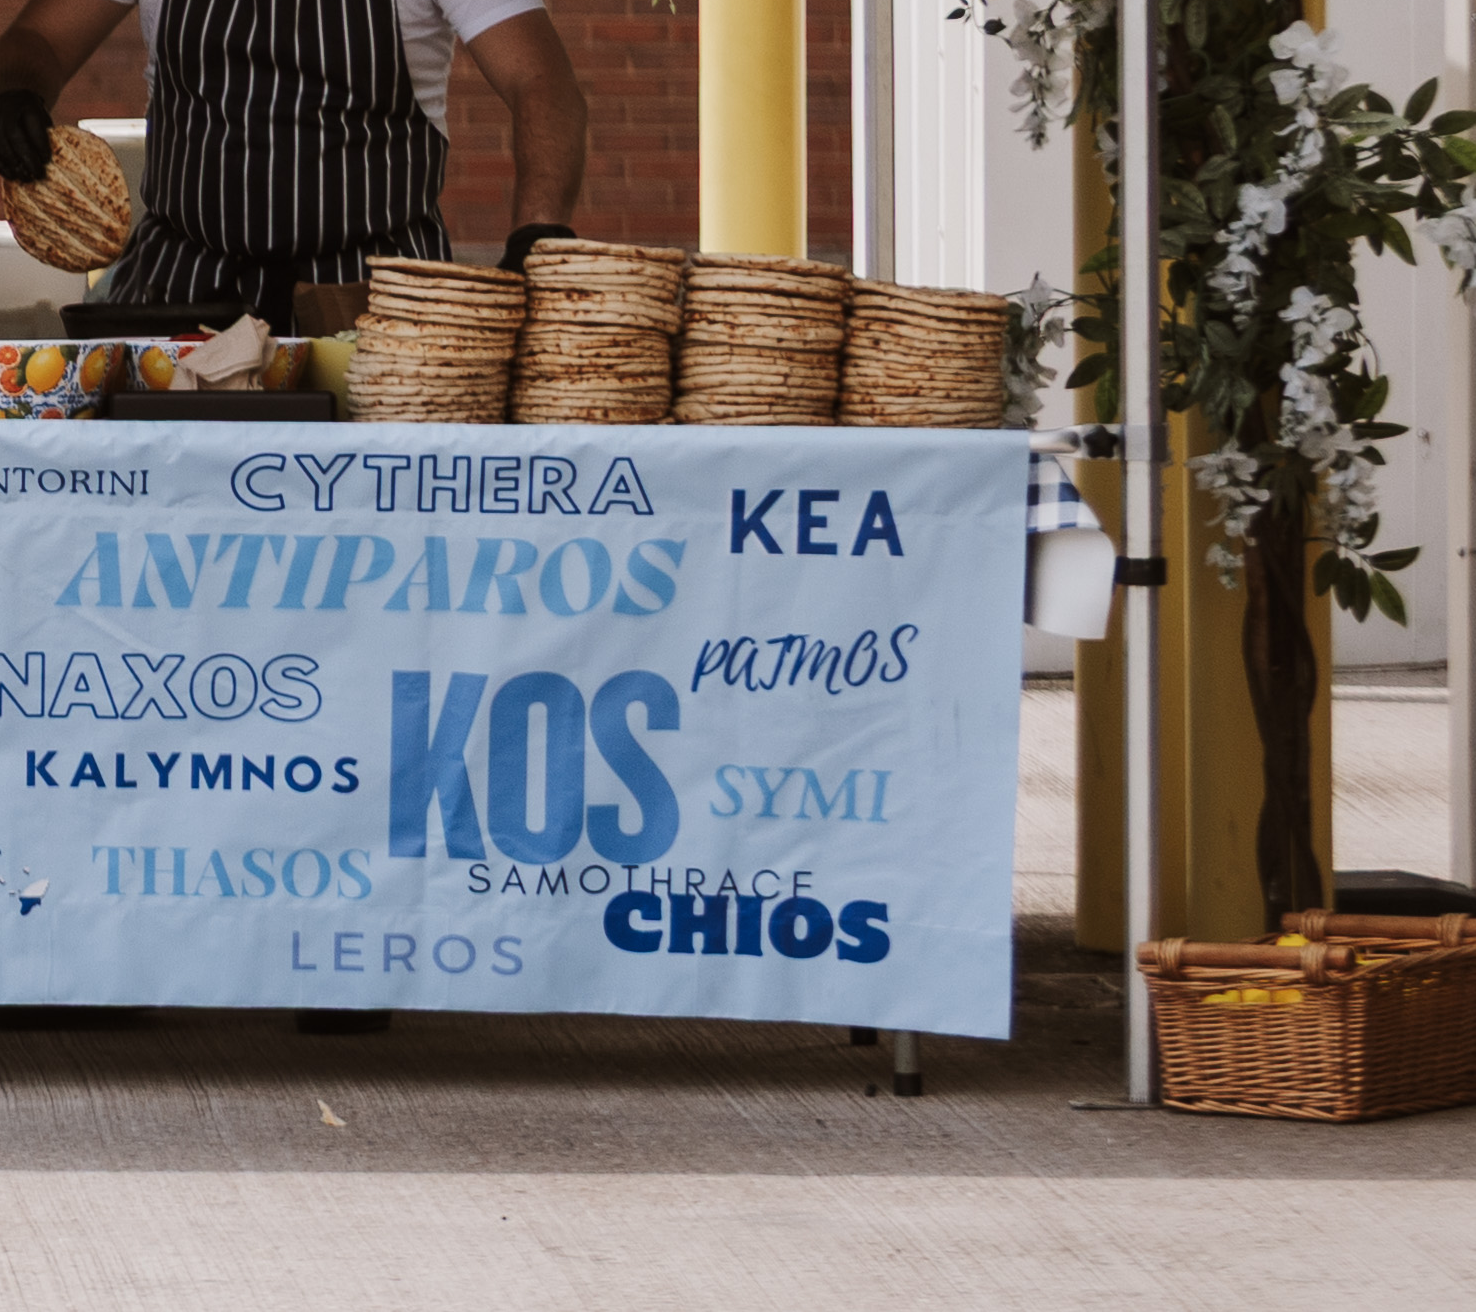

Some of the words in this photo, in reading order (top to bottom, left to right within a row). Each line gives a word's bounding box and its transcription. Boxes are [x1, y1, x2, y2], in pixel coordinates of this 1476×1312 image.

[229, 452, 655, 517] CYTHERA
[730, 488, 905, 557] KEA
[54, 531, 688, 617] ANTIPAROS
[26, 749, 360, 795] KALYMNOS
[388, 669, 681, 867] KOS
[709, 763, 891, 823] SYMI
[92, 845, 373, 900] THASOS
[468, 863, 814, 900] SAMOTHRACE
[291, 930, 524, 977] LEROS
[603, 890, 891, 964] CHIOS
